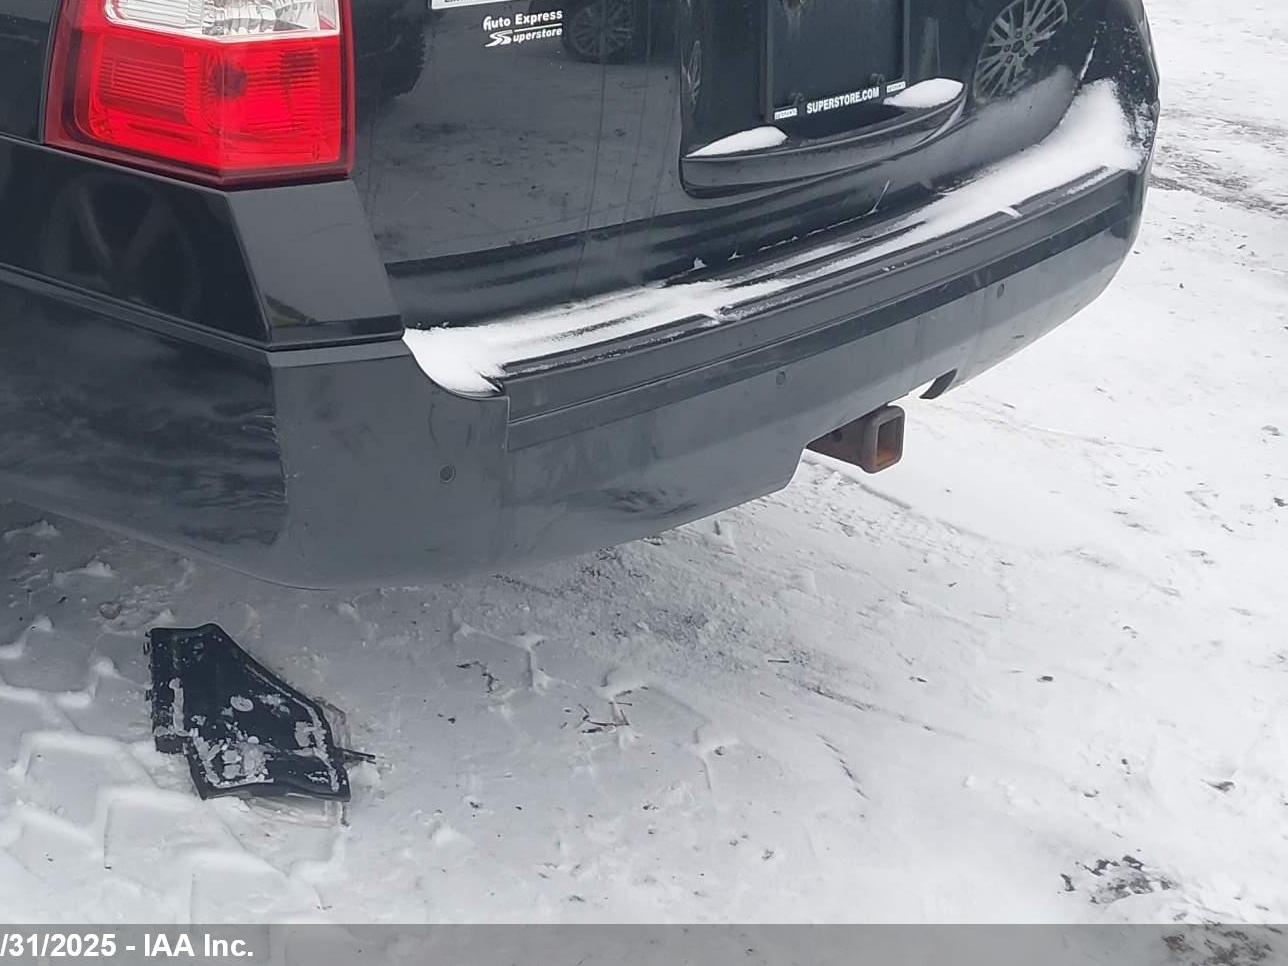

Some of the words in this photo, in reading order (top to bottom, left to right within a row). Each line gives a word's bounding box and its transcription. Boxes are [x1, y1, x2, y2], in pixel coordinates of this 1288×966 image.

[483, 15, 510, 31] Auto
[515, 10, 563, 25] Express
[806, 86, 880, 114] SUPERSTORE.COM
